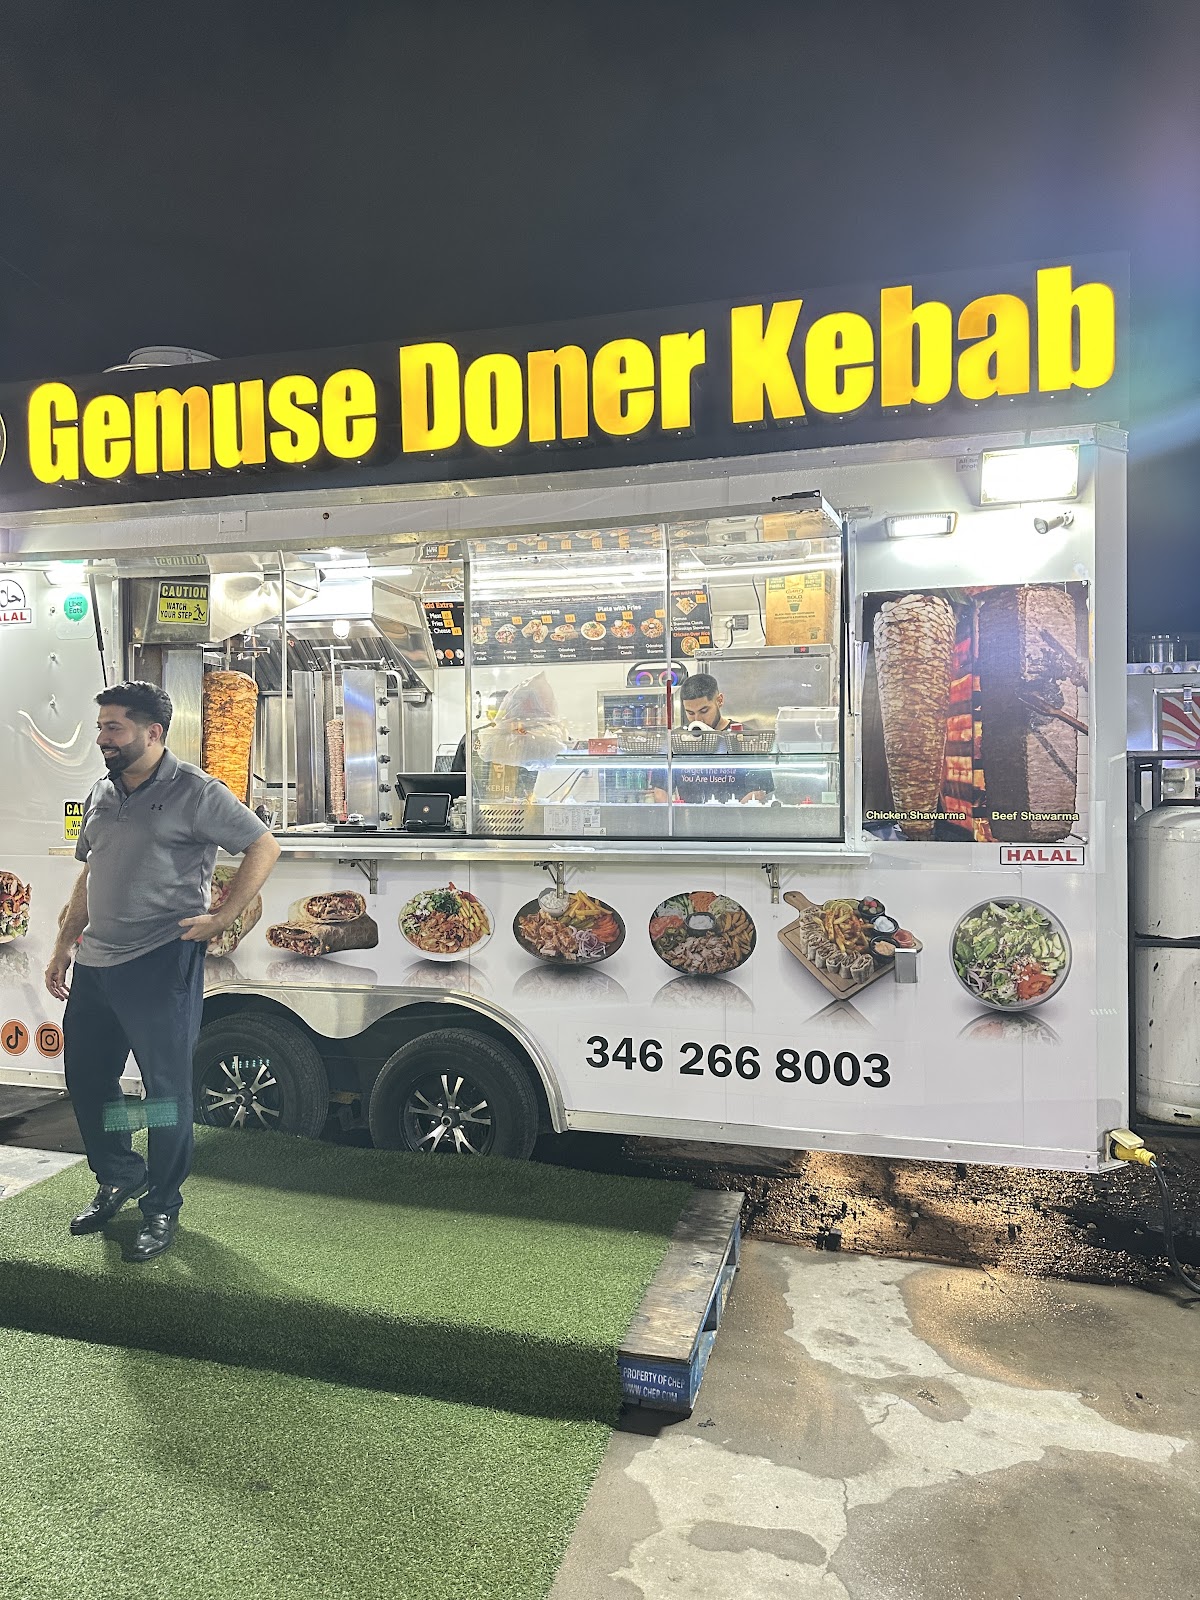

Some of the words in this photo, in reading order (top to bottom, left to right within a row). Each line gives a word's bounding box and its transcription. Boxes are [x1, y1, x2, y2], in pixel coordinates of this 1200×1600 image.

[28, 368, 377, 484] Gemuse
[400, 329, 706, 454] Doner
[731, 265, 1116, 424] Kebab
[162, 585, 207, 598] CAUTION
[166, 602, 187, 610] WATCH
[160, 610, 176, 618] YOUR
[177, 611, 192, 619] STEP
[865, 810, 909, 821] Chicken
[909, 811, 966, 822] Shawarma
[991, 811, 1018, 822] Beef
[1020, 811, 1080, 822] Shawarma
[1006, 849, 1078, 863] HALAL
[585, 1035, 664, 1072] 346
[679, 1042, 761, 1080] 266
[774, 1048, 892, 1088] 8003
[623, 1367, 657, 1384] PROPERTY
[657, 1374, 667, 1385] OF
[667, 1376, 686, 1389] CHEP
